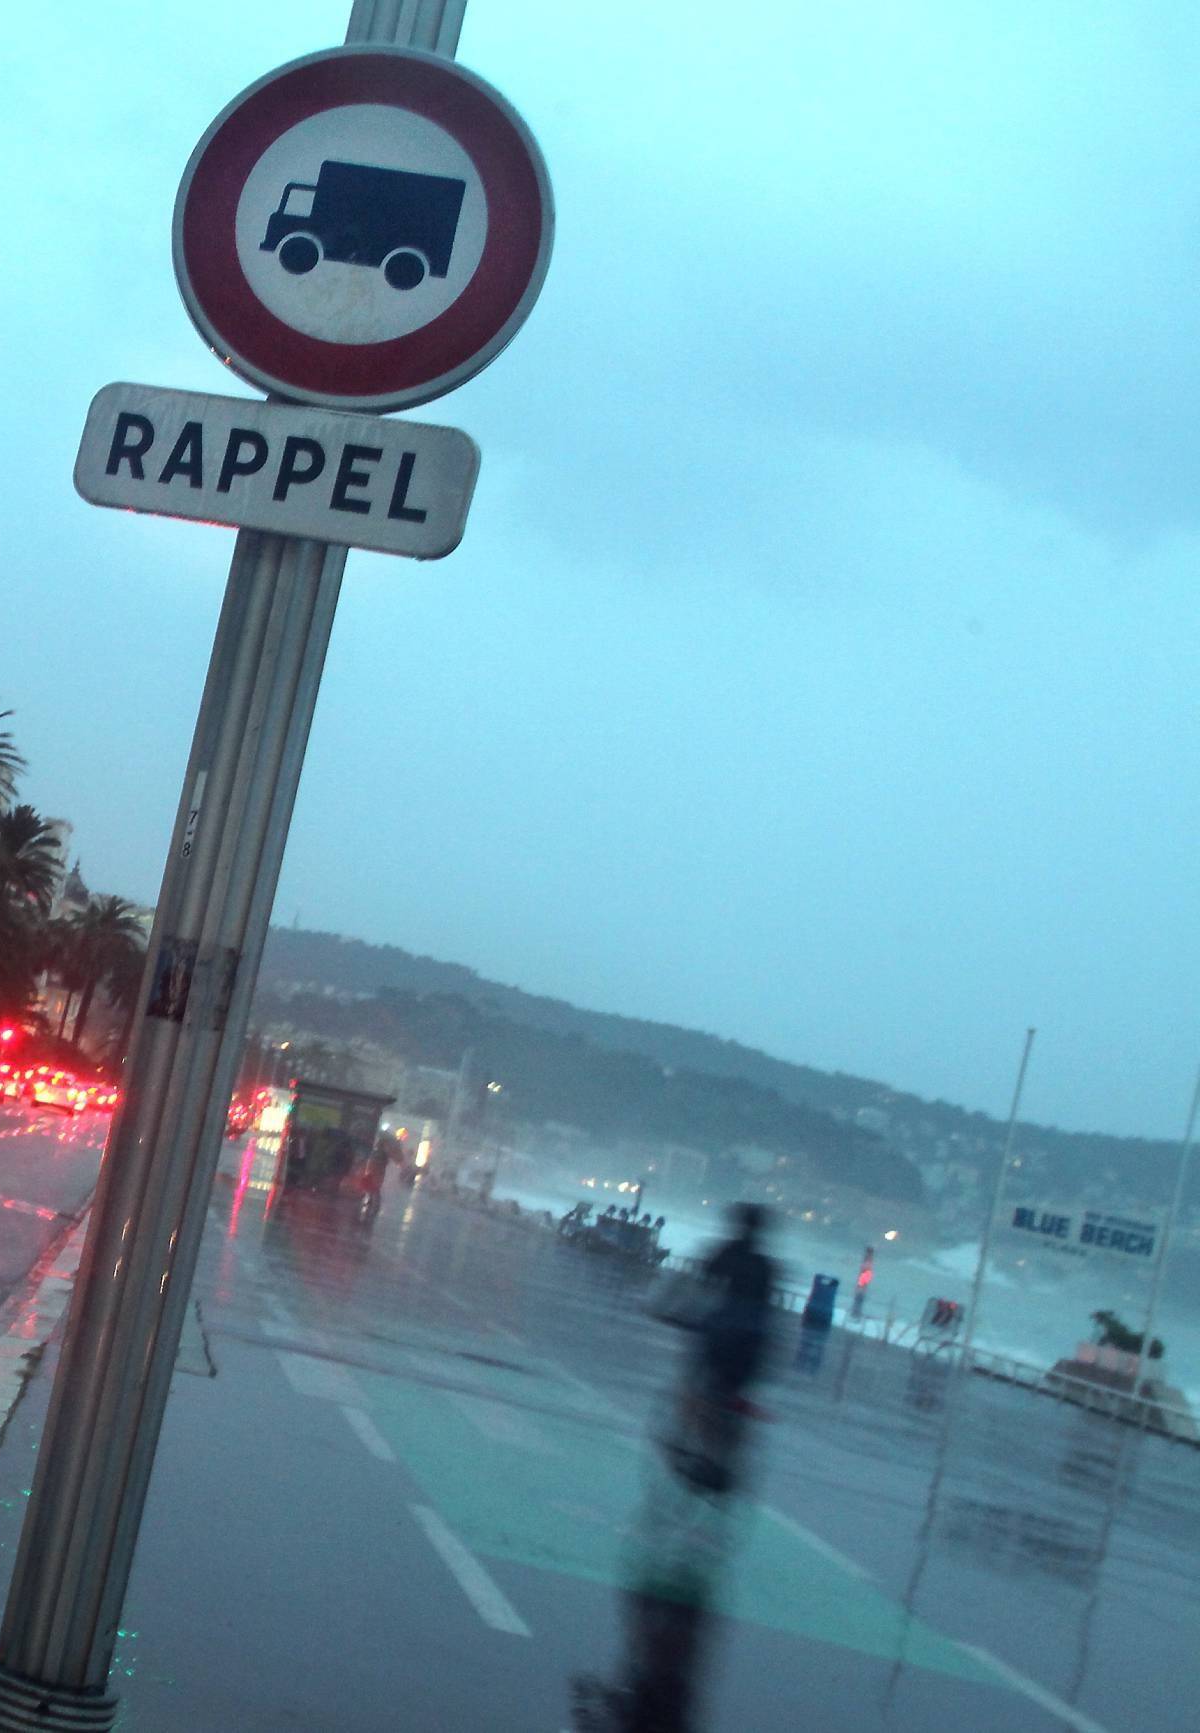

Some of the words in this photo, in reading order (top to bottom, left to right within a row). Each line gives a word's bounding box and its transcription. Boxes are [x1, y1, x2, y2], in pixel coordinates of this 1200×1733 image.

[105, 411, 427, 524] RAPPEL
[1013, 1207, 1070, 1239] BLUE
[1080, 1223, 1155, 1257] BEACH
